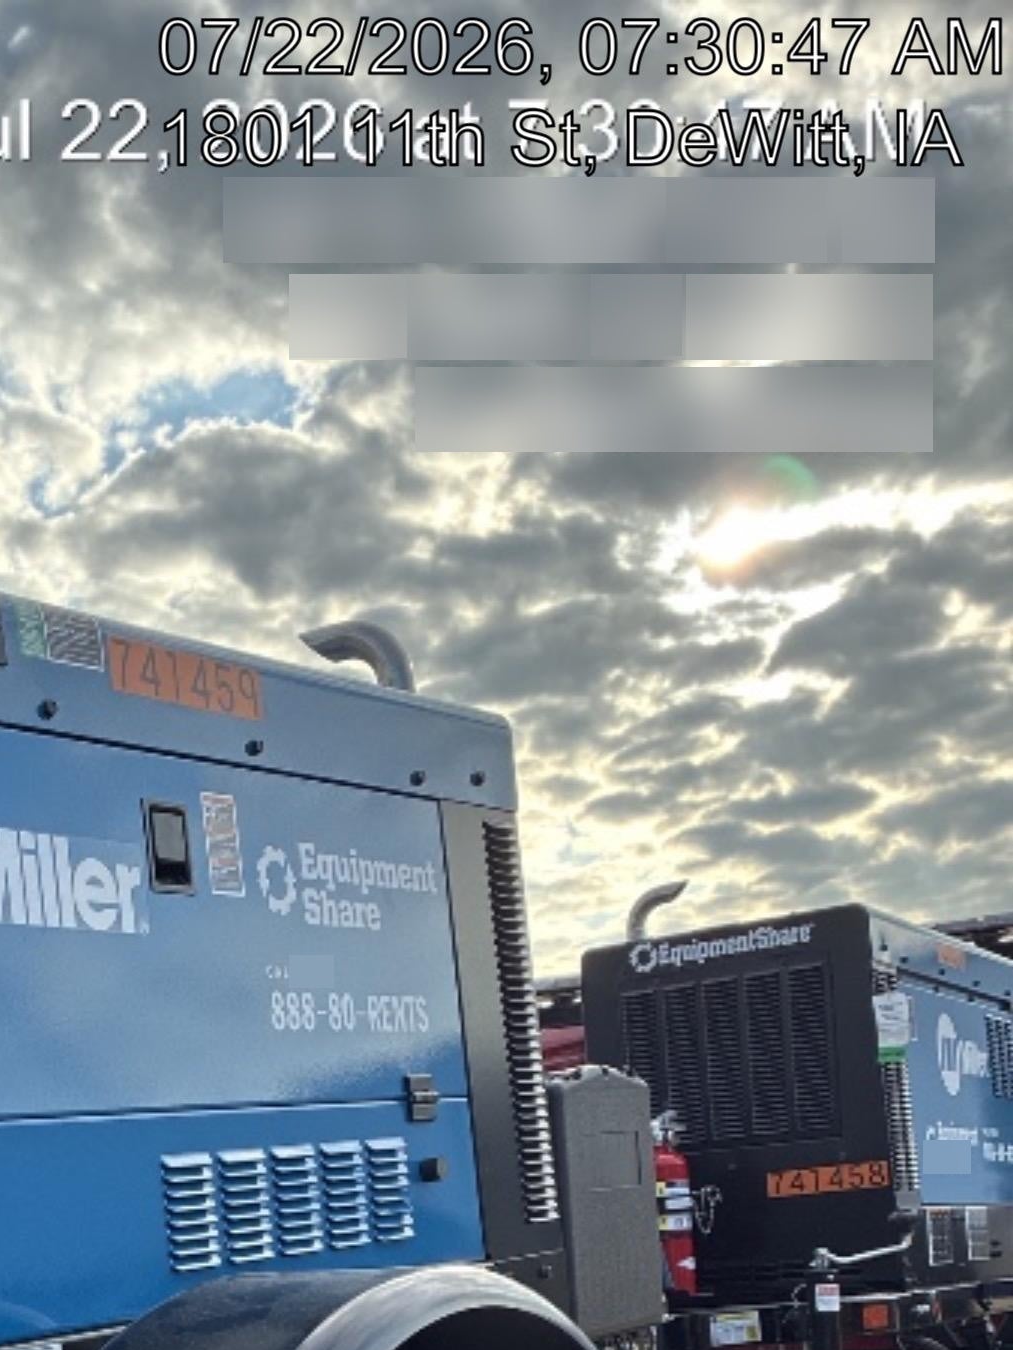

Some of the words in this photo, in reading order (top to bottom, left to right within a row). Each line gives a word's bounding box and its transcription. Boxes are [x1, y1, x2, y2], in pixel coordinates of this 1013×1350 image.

[110, 638, 260, 717] 741459
[298, 842, 438, 894] Equipment
[302, 887, 382, 931] Share
[659, 925, 811, 968] EquipmentShare
[773, 1162, 886, 1196] 741458
